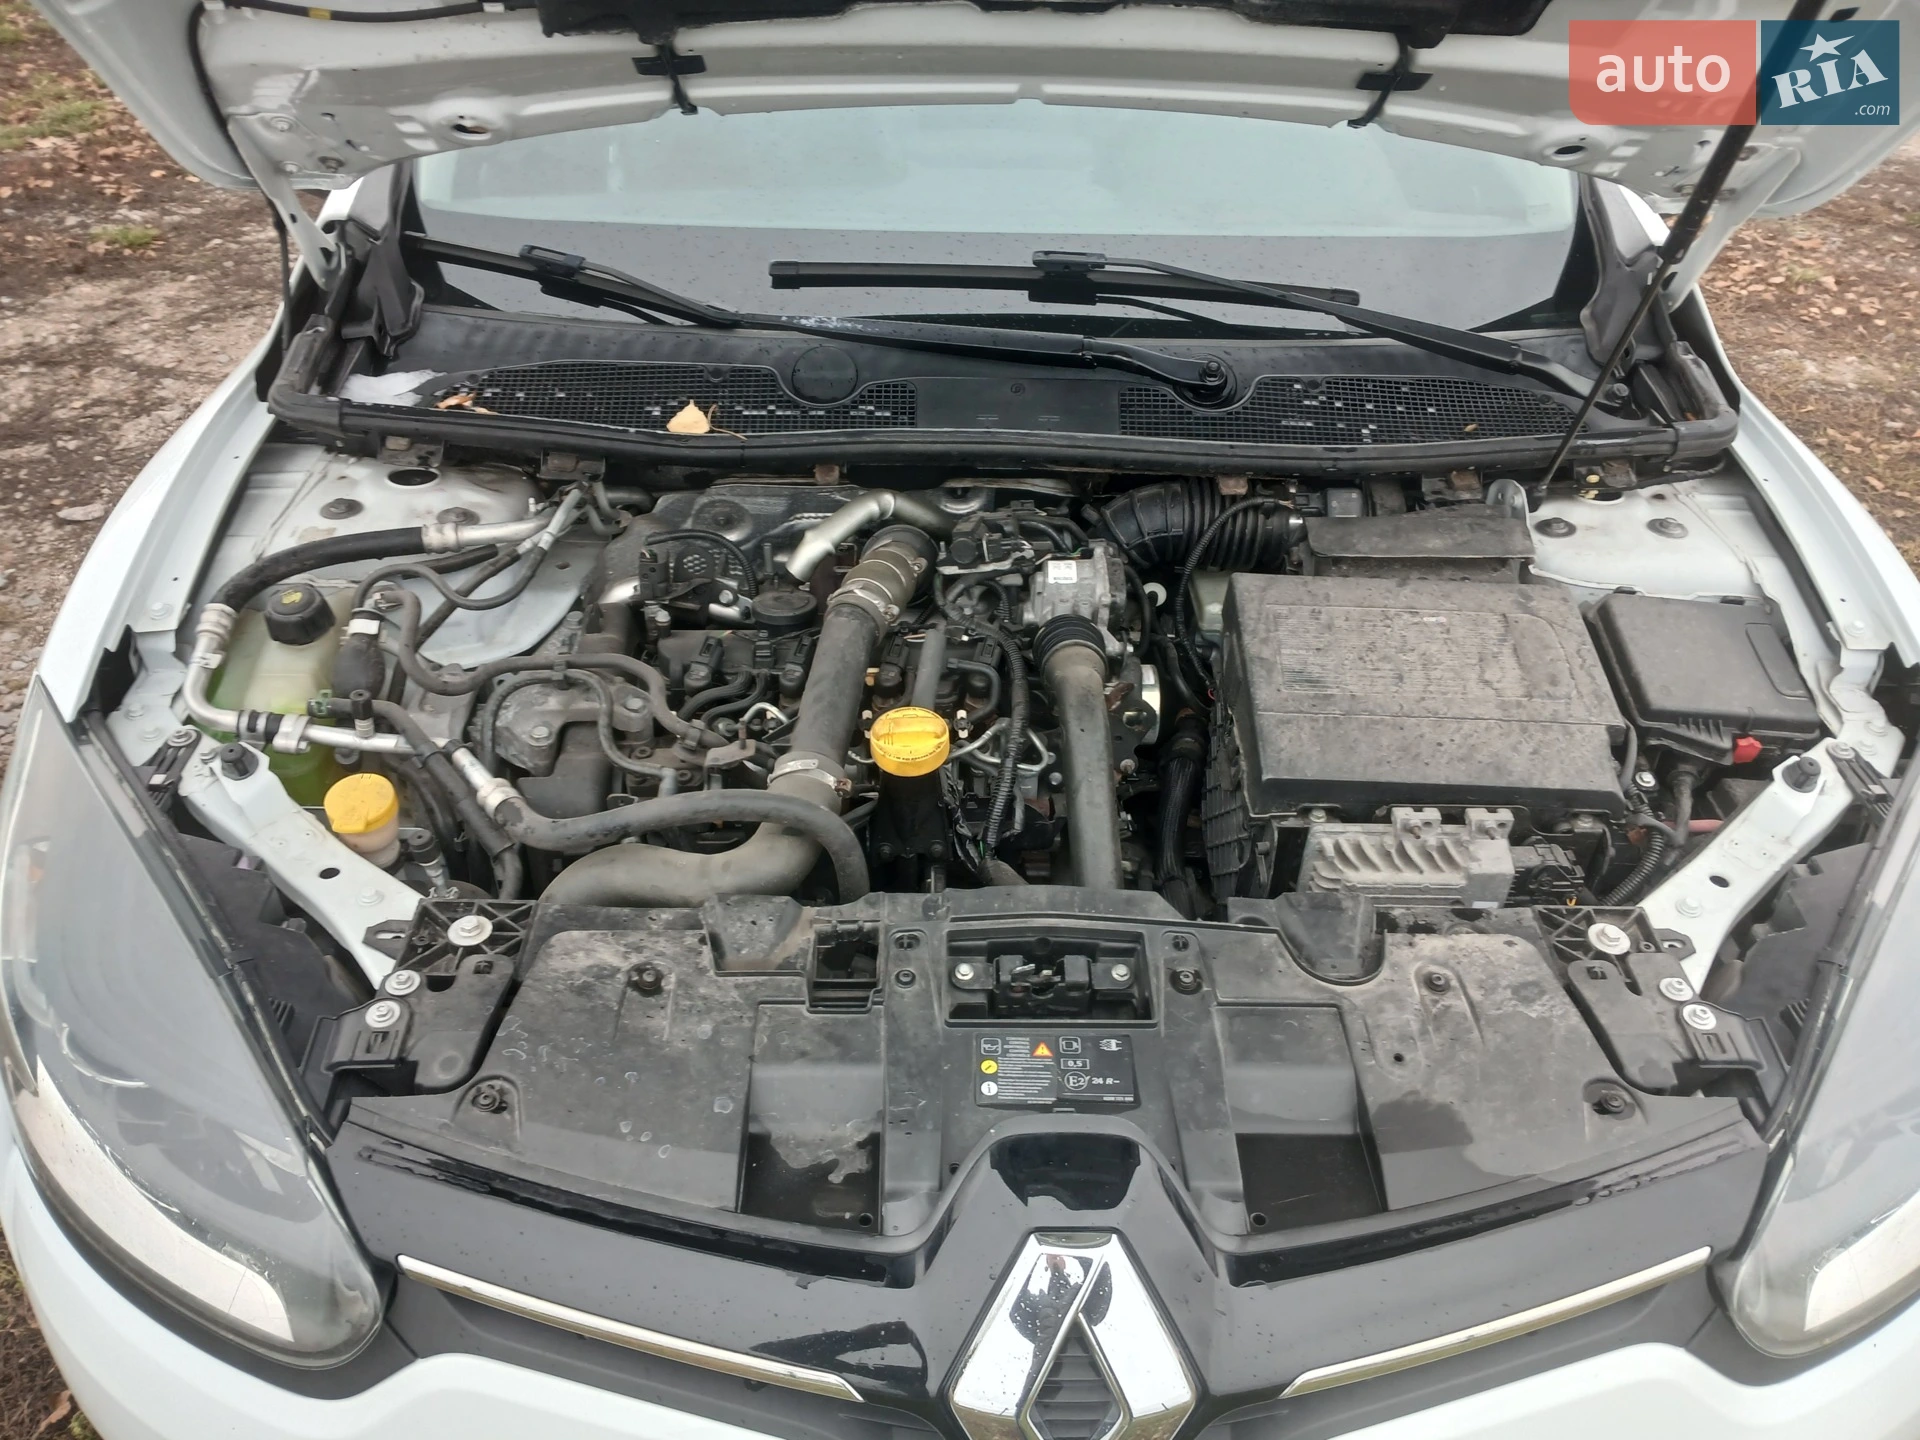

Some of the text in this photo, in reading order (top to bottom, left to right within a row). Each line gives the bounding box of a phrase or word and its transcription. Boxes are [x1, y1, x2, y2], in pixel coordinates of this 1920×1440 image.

[1067, 1060, 1083, 1068] 0,5
[1068, 1075, 1085, 1087] E2
[1091, 1077, 1104, 1085] 24
